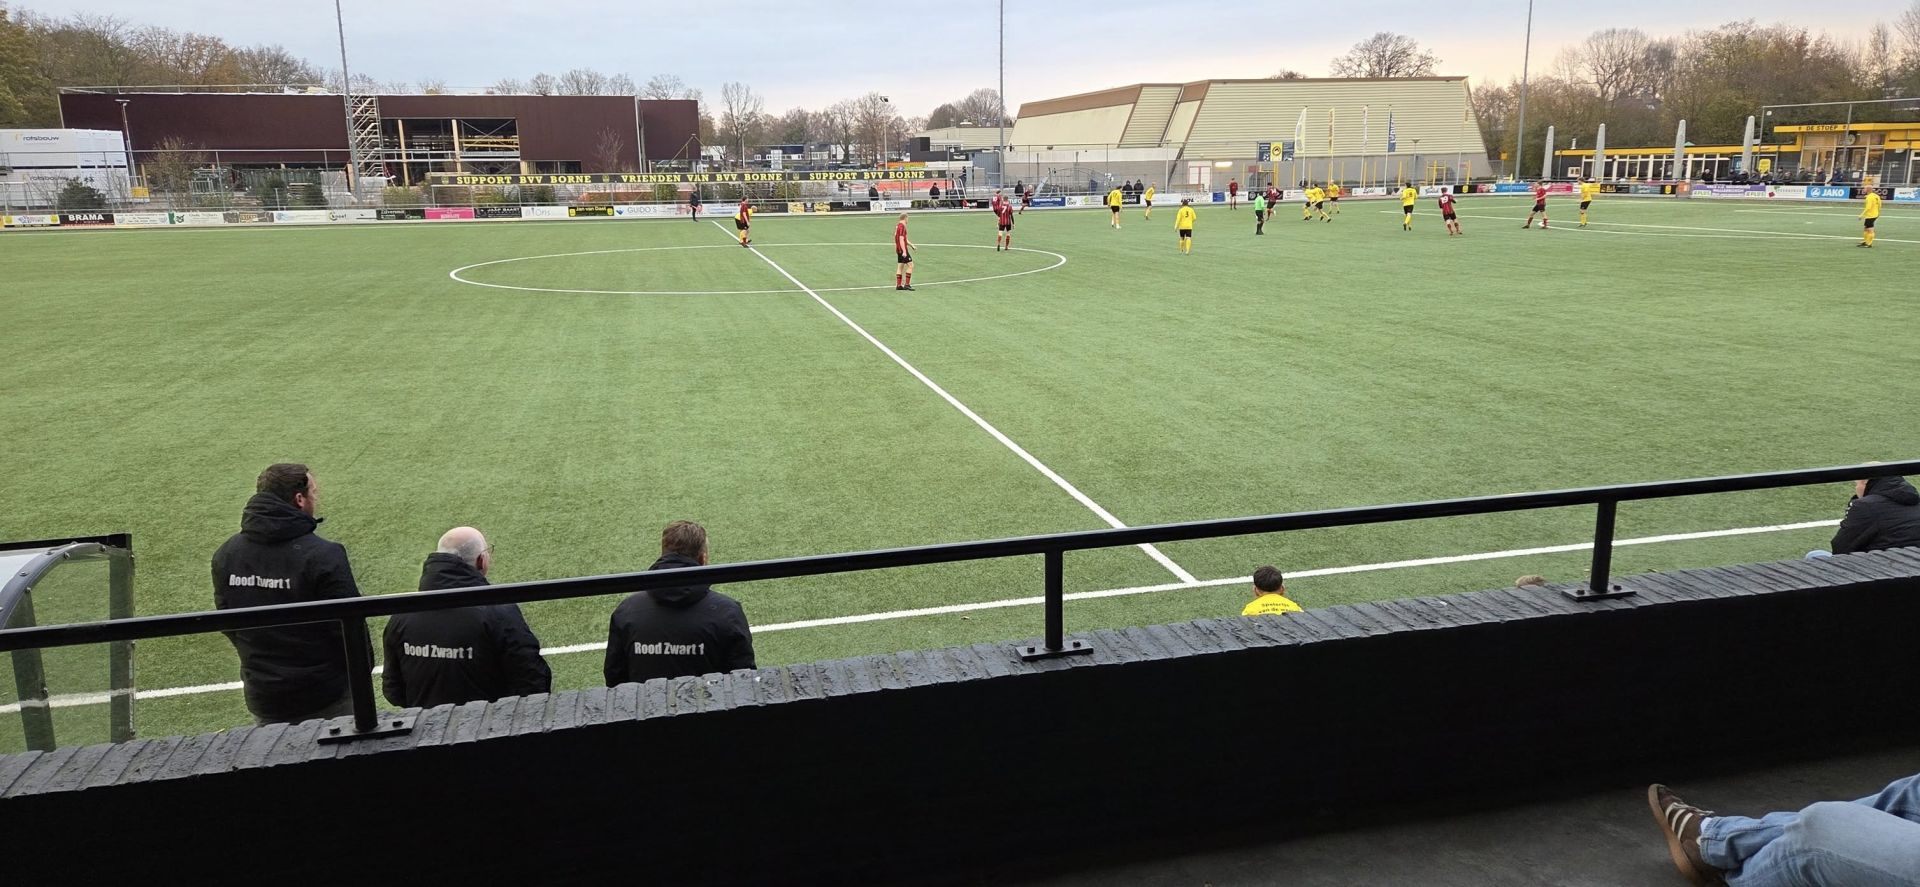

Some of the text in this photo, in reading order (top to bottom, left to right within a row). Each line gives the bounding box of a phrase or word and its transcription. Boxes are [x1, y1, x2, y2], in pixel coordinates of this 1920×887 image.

[456, 175, 592, 185] SUPPORT BVV BORNE
[621, 173, 783, 183] VRIENDEN VAN BVV BORNE
[809, 171, 925, 180] SUPPORT BVV BORNE
[1821, 189, 1845, 197] JAKO
[1002, 206, 1008, 214] 7
[68, 213, 104, 221] BRAMA
[229, 574, 291, 589] Rood Zwart 1
[403, 642, 473, 659] Rood Zwart 1
[634, 642, 705, 655] Rood Zwart 1
